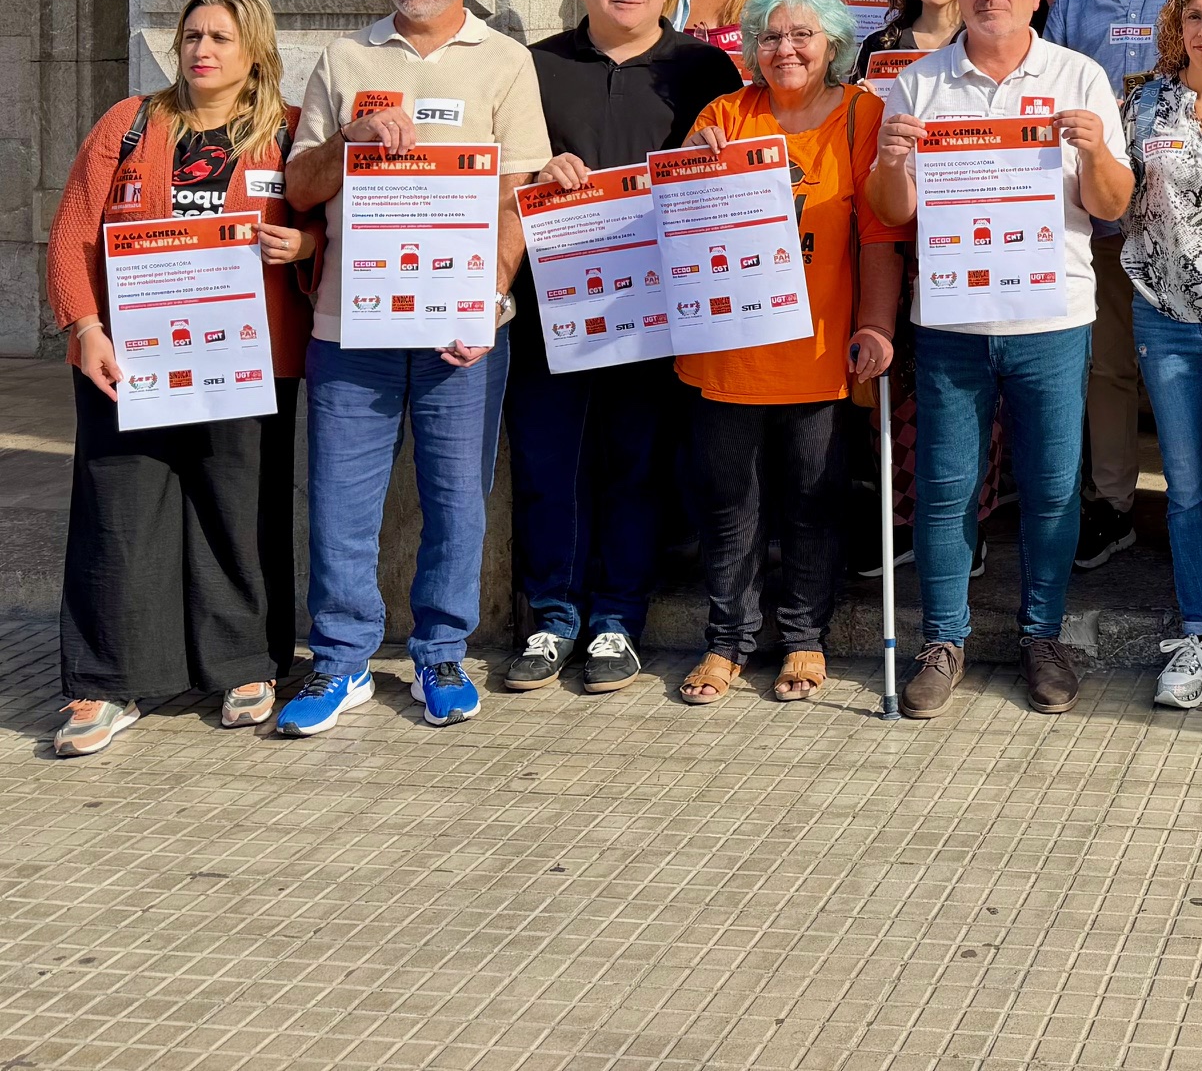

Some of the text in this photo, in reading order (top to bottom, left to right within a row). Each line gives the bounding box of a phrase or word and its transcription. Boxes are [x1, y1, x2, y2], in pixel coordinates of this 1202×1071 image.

[953, 127, 992, 136] GENERAL
[1021, 125, 1053, 141] 11N
[942, 136, 1000, 145] L'HABITATGE
[457, 153, 491, 169] 11N
[654, 154, 718, 169] VAGA GENERAL
[746, 146, 780, 166] 11N
[655, 162, 728, 178] PER L'HABITATGE
[250, 181, 283, 194] STE
[113, 227, 188, 241] VAGA GENERAL
[218, 222, 252, 241] 11N
[114, 236, 198, 250] PER L'HABITATGE
[712, 264, 727, 272] CGT
[742, 257, 758, 266] CNT
